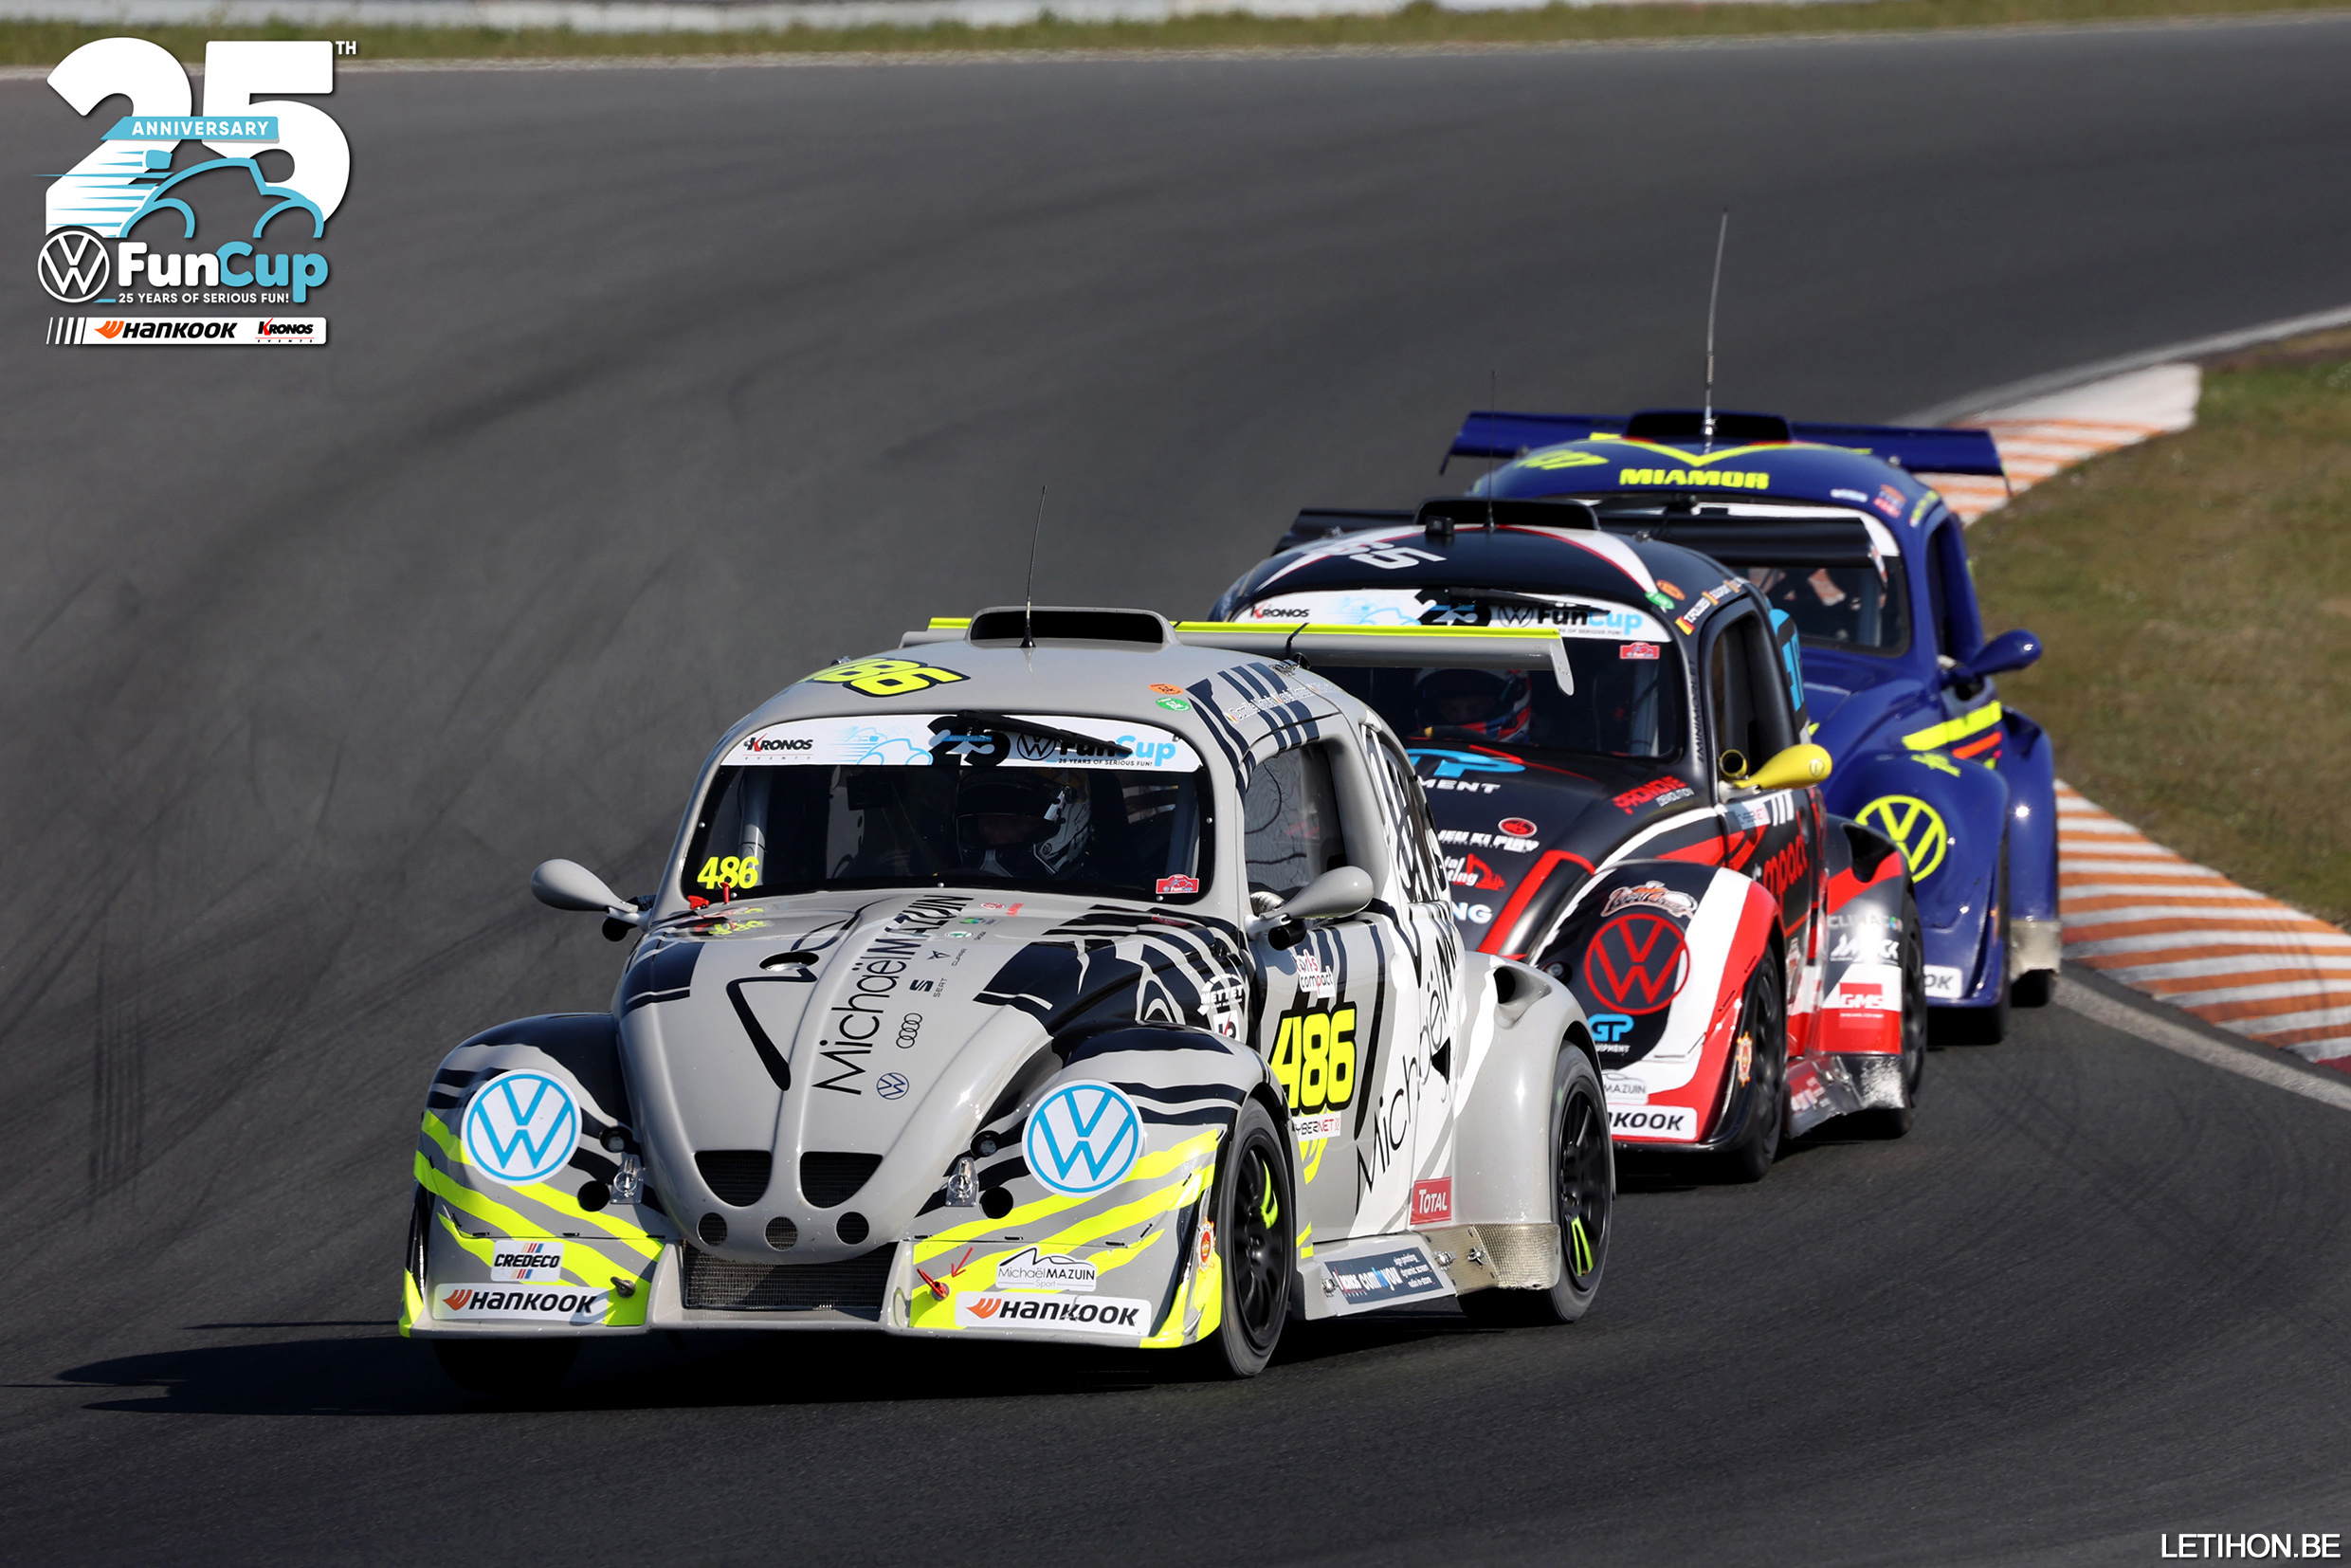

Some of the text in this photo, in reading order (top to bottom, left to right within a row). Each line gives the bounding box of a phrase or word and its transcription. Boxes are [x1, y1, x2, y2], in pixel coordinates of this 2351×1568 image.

[1620, 468, 1769, 490] MIAMOR
[1250, 601, 1310, 618] KRONOS
[746, 733, 813, 752] KRONOS
[697, 856, 759, 889] 486
[1200, 985, 1244, 1004] METTET
[1841, 994, 1883, 1009] GMS
[1270, 1008, 1356, 1109] 486
[1418, 1189, 1448, 1214] TOTAL
[494, 1253, 560, 1268] CREDECO
[1035, 1280, 1056, 1288] Sport
